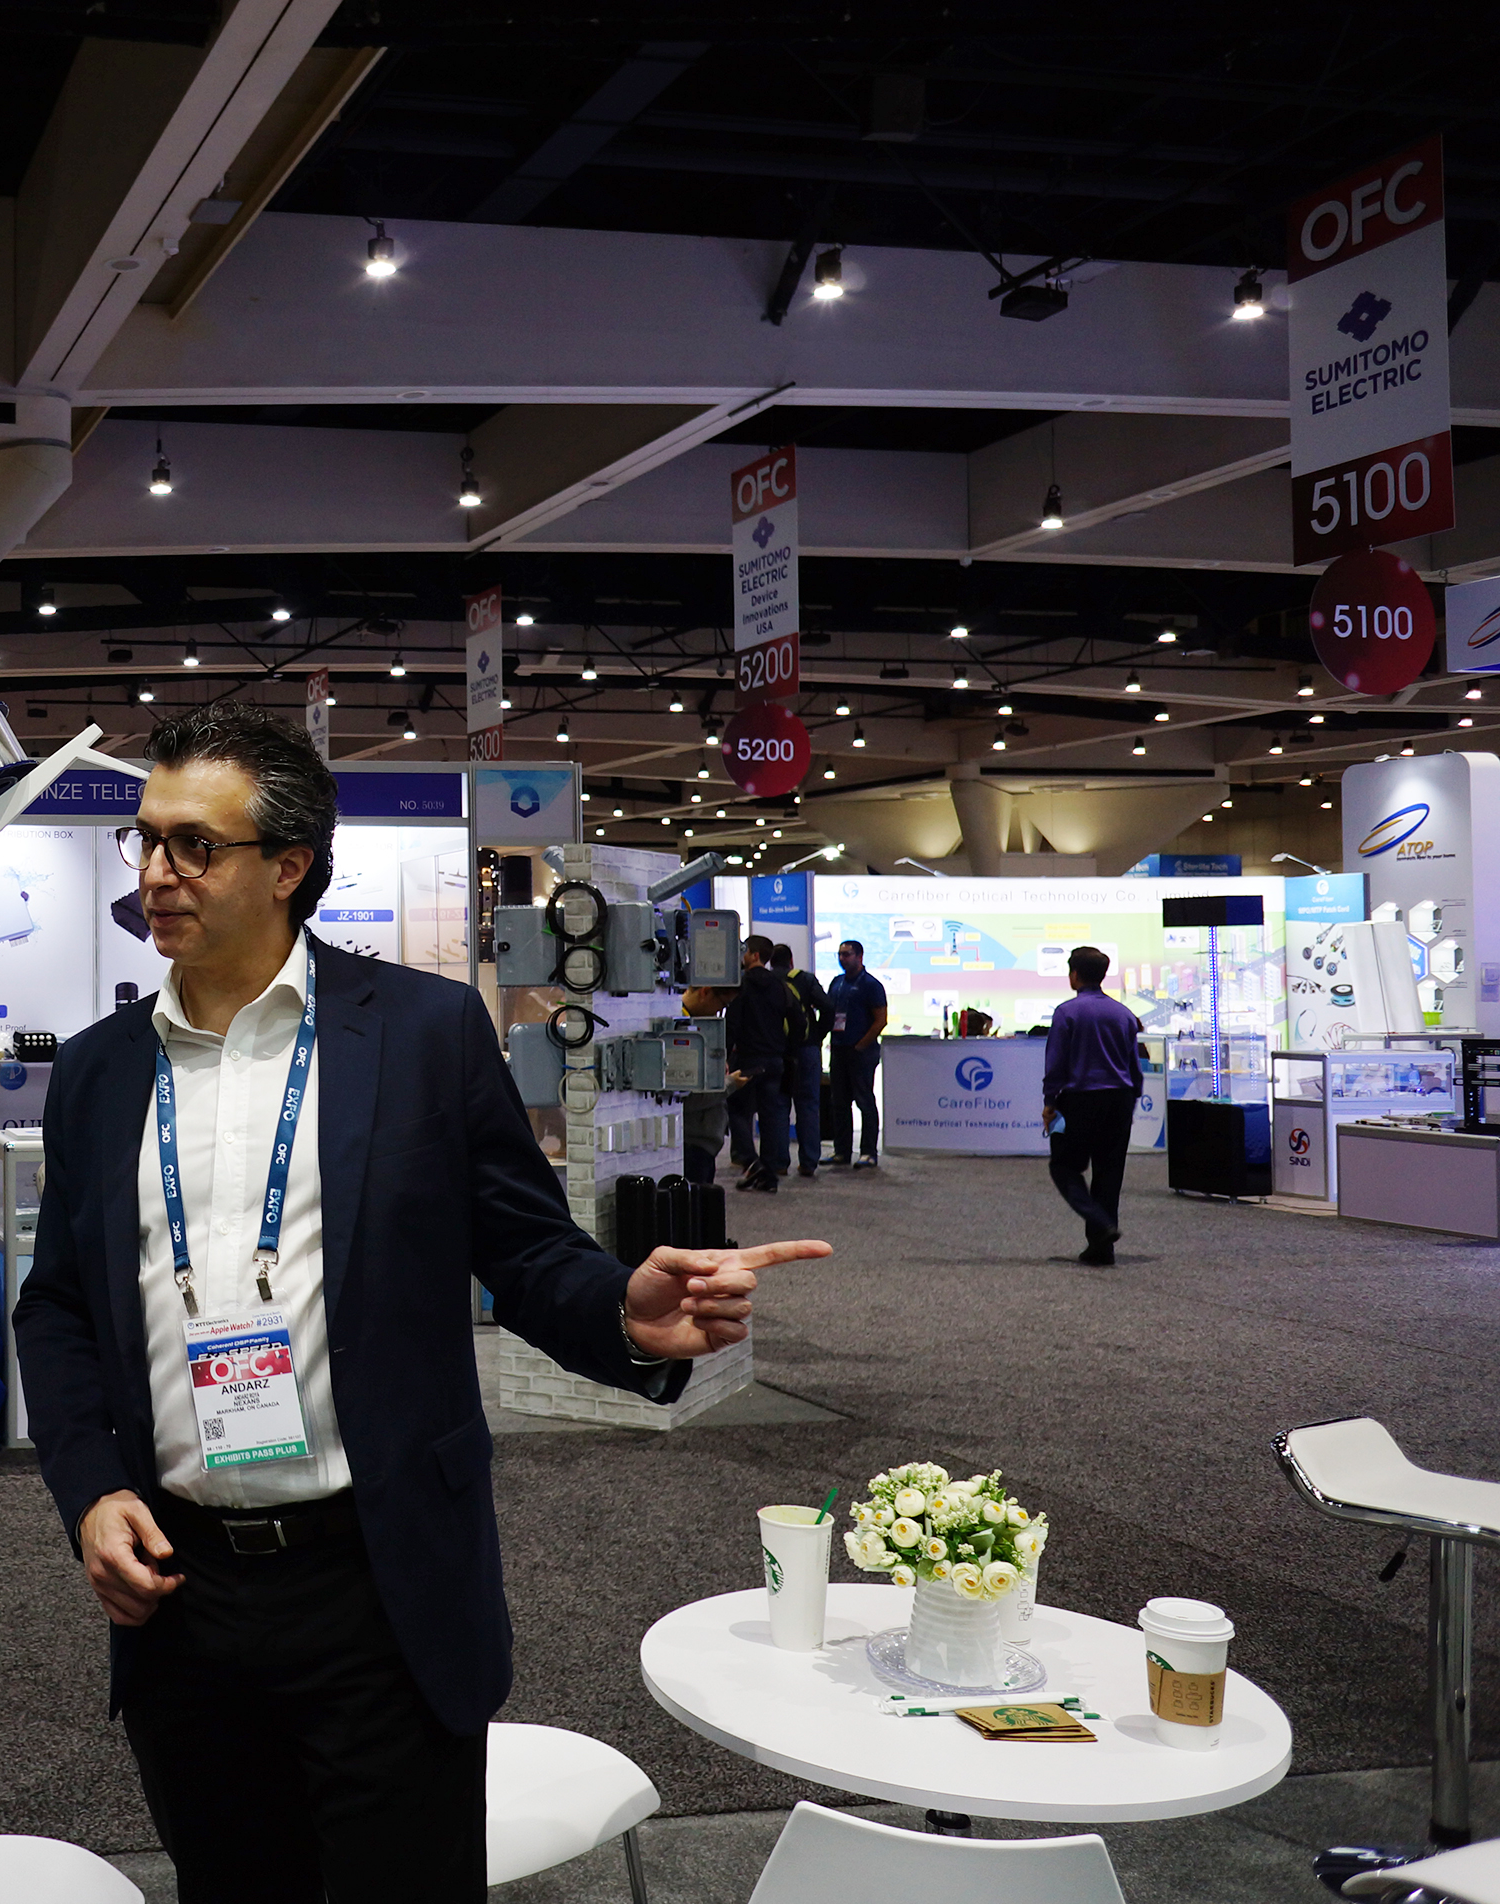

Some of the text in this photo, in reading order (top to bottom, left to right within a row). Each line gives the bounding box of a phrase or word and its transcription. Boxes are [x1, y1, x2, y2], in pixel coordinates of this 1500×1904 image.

[1301, 161, 1427, 262] OFC
[1305, 330, 1429, 390] SUMITOMO
[1311, 359, 1422, 415] ELECTRIC
[736, 457, 790, 514] OFC
[1310, 451, 1431, 535] 5100
[738, 546, 791, 578] SUMITOMO
[741, 565, 789, 594] ELECTRIC
[751, 587, 779, 607] Device
[469, 594, 498, 630] OFC
[742, 601, 789, 624] Innovations
[1333, 605, 1413, 640] 5100
[756, 621, 773, 635] USA
[739, 641, 793, 692] 5200
[470, 730, 500, 762] 5300
[736, 738, 794, 762] 5200
[38, 784, 83, 800] INZE
[400, 801, 444, 810] NO. 5039
[2, 830, 74, 839] TRIBUTION BOX
[1397, 841, 1434, 856] ATOP
[959, 890, 1013, 903] Optical
[1022, 890, 1107, 903] Technology
[337, 911, 374, 920] JZ-1901
[305, 994, 316, 1026] EXFO
[296, 1046, 308, 1067] OFC
[158, 1074, 170, 1104] EXFO
[283, 1087, 300, 1122] EXFO
[938, 1097, 1011, 1109] CareFiber
[162, 1123, 171, 1143] OFC
[275, 1143, 288, 1165] OFC
[164, 1164, 177, 1199] EXFO
[266, 1187, 282, 1224] EXFO
[173, 1220, 181, 1243] OFC
[210, 1326, 229, 1335] Apple
[230, 1321, 254, 1331] Watch?
[257, 1315, 283, 1326] #2931
[210, 1352, 273, 1382] OFC
[221, 1379, 270, 1395] ANDARZ
[233, 1398, 260, 1407] NEXANS
[256, 1401, 280, 1409] CANADA
[214, 1445, 297, 1464] EXHIBITS PASS PLUS
